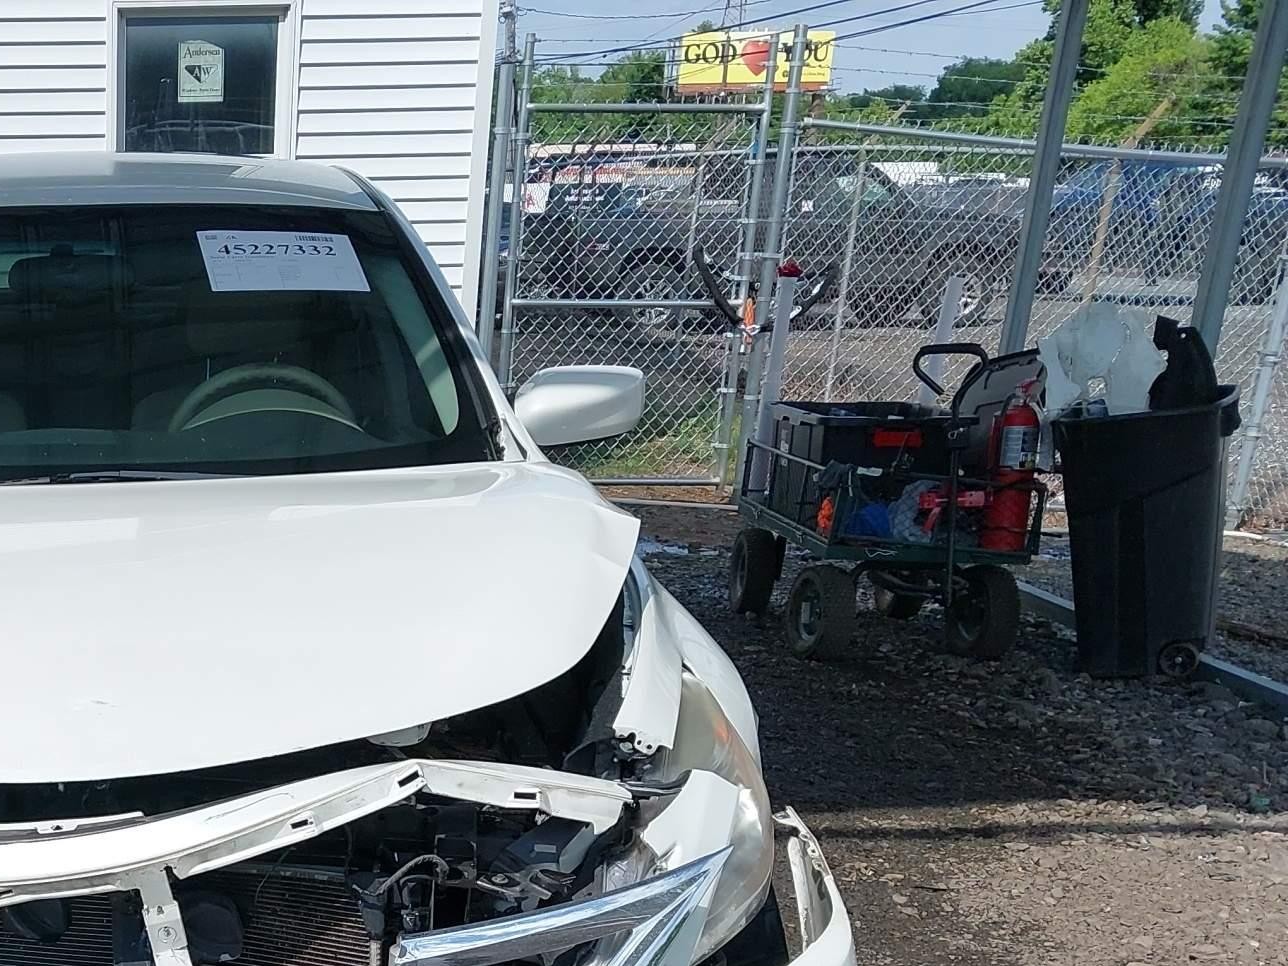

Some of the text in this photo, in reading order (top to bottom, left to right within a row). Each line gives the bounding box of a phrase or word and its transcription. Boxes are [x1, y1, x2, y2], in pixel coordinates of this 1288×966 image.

[183, 46, 221, 59] Andersen
[685, 43, 738, 64] GOD
[217, 243, 337, 256] 45227332
